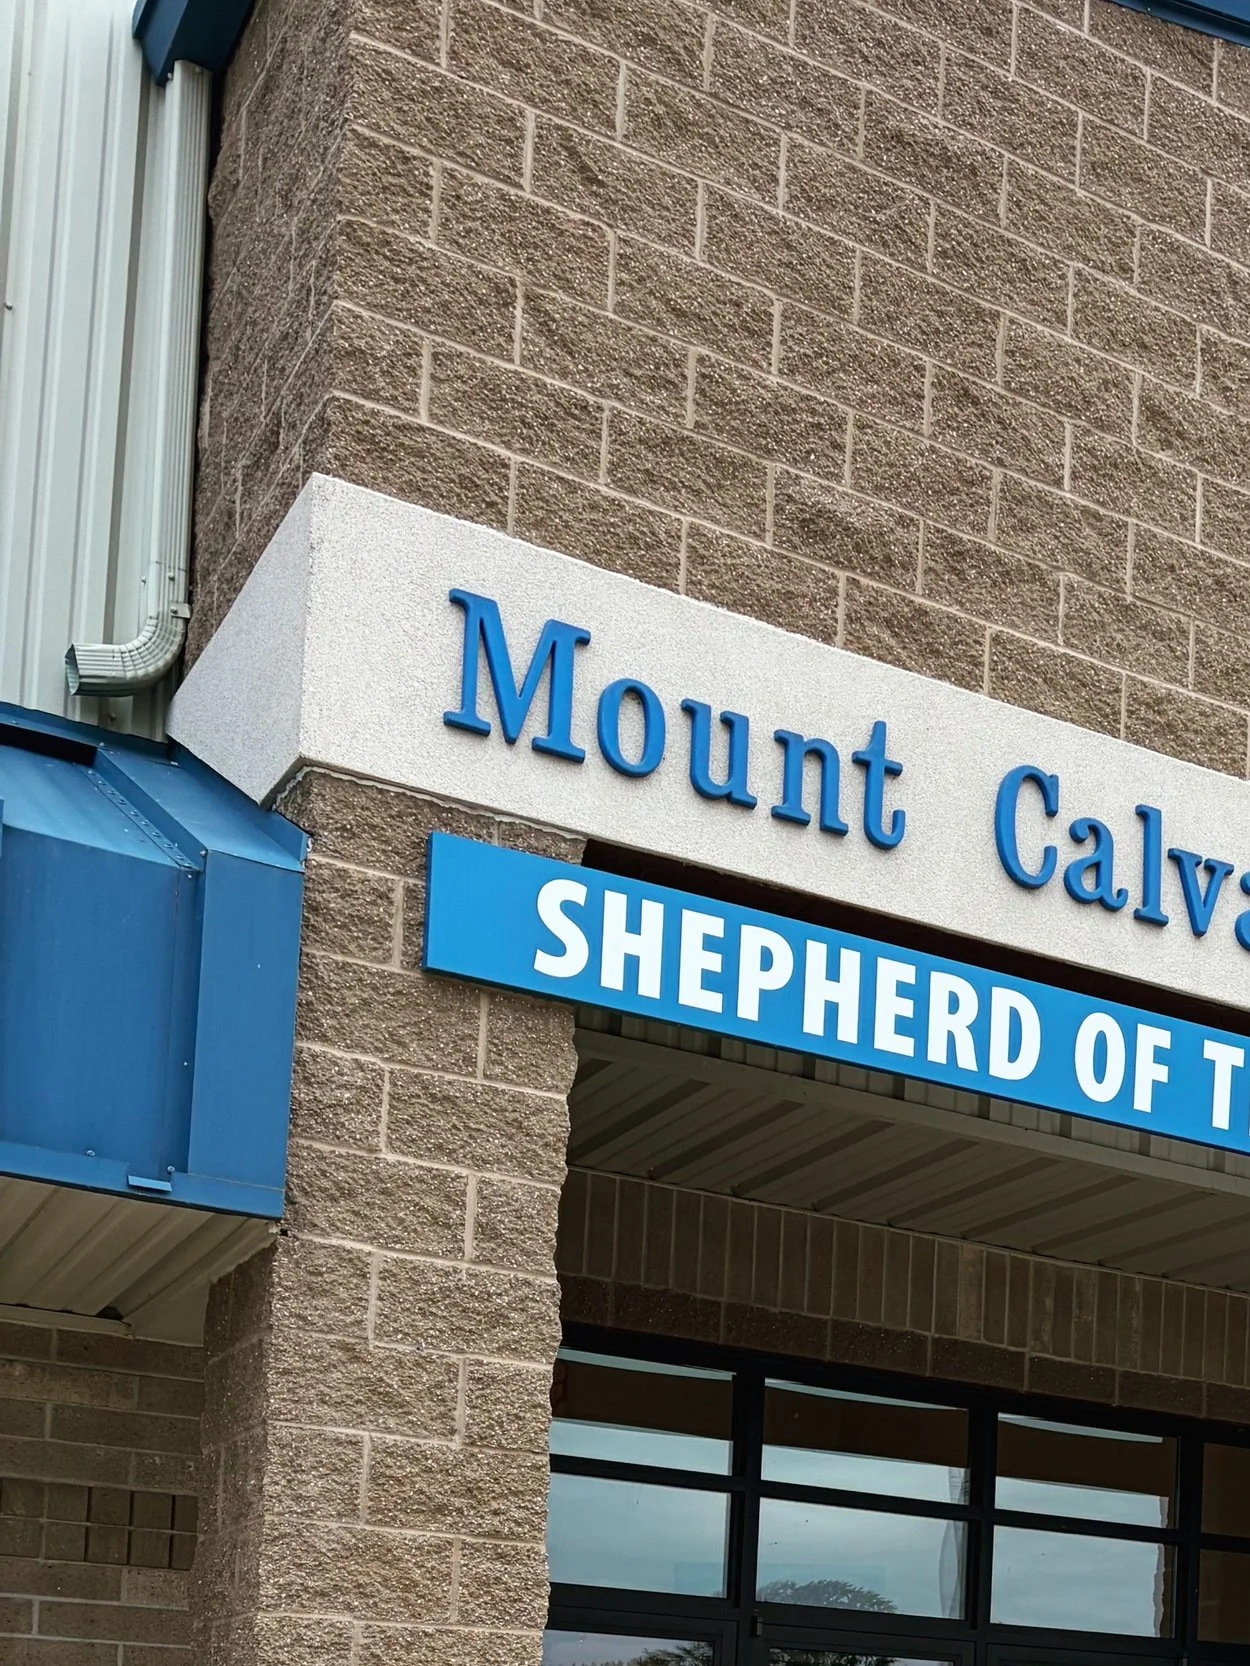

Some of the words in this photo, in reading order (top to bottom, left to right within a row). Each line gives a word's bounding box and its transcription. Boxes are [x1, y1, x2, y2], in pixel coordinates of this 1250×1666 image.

[443, 587, 906, 851] Mount
[533, 878, 1042, 1082] SHEPHERD
[1073, 1011, 1172, 1114] OF
